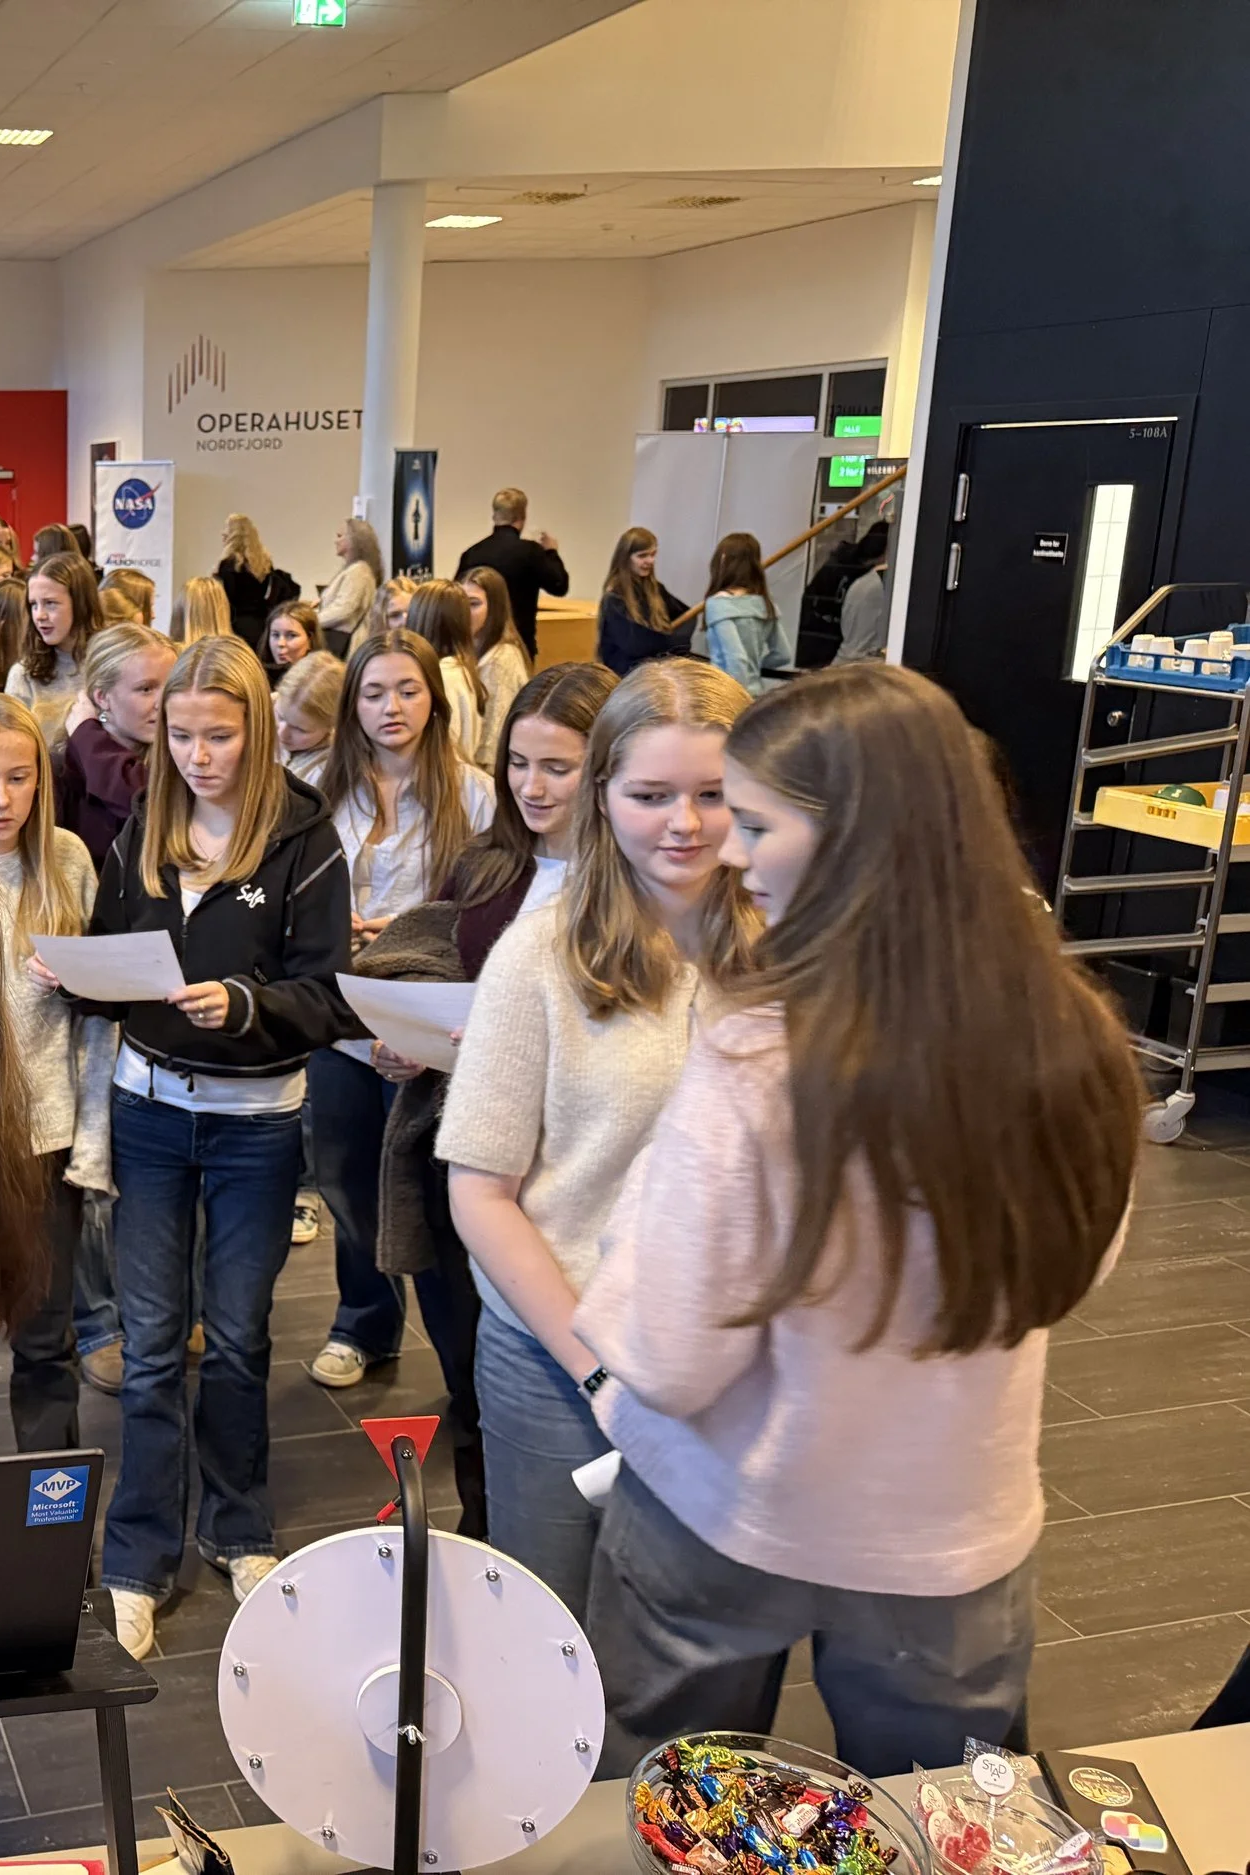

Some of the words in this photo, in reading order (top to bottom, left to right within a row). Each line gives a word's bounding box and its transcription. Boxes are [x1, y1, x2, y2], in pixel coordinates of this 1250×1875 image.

[197, 410, 363, 433] OPERAHUSET
[1129, 426, 1167, 439] 5-108A
[196, 438, 283, 451] NORDFJORD
[115, 498, 153, 510] NASA
[42, 1480, 76, 1492] MVP
[32, 1500, 76, 1511] Microsoft
[50, 1508, 79, 1516] Valuable
[34, 1514, 75, 1523] Professional
[982, 1759, 1007, 1778] STAD
